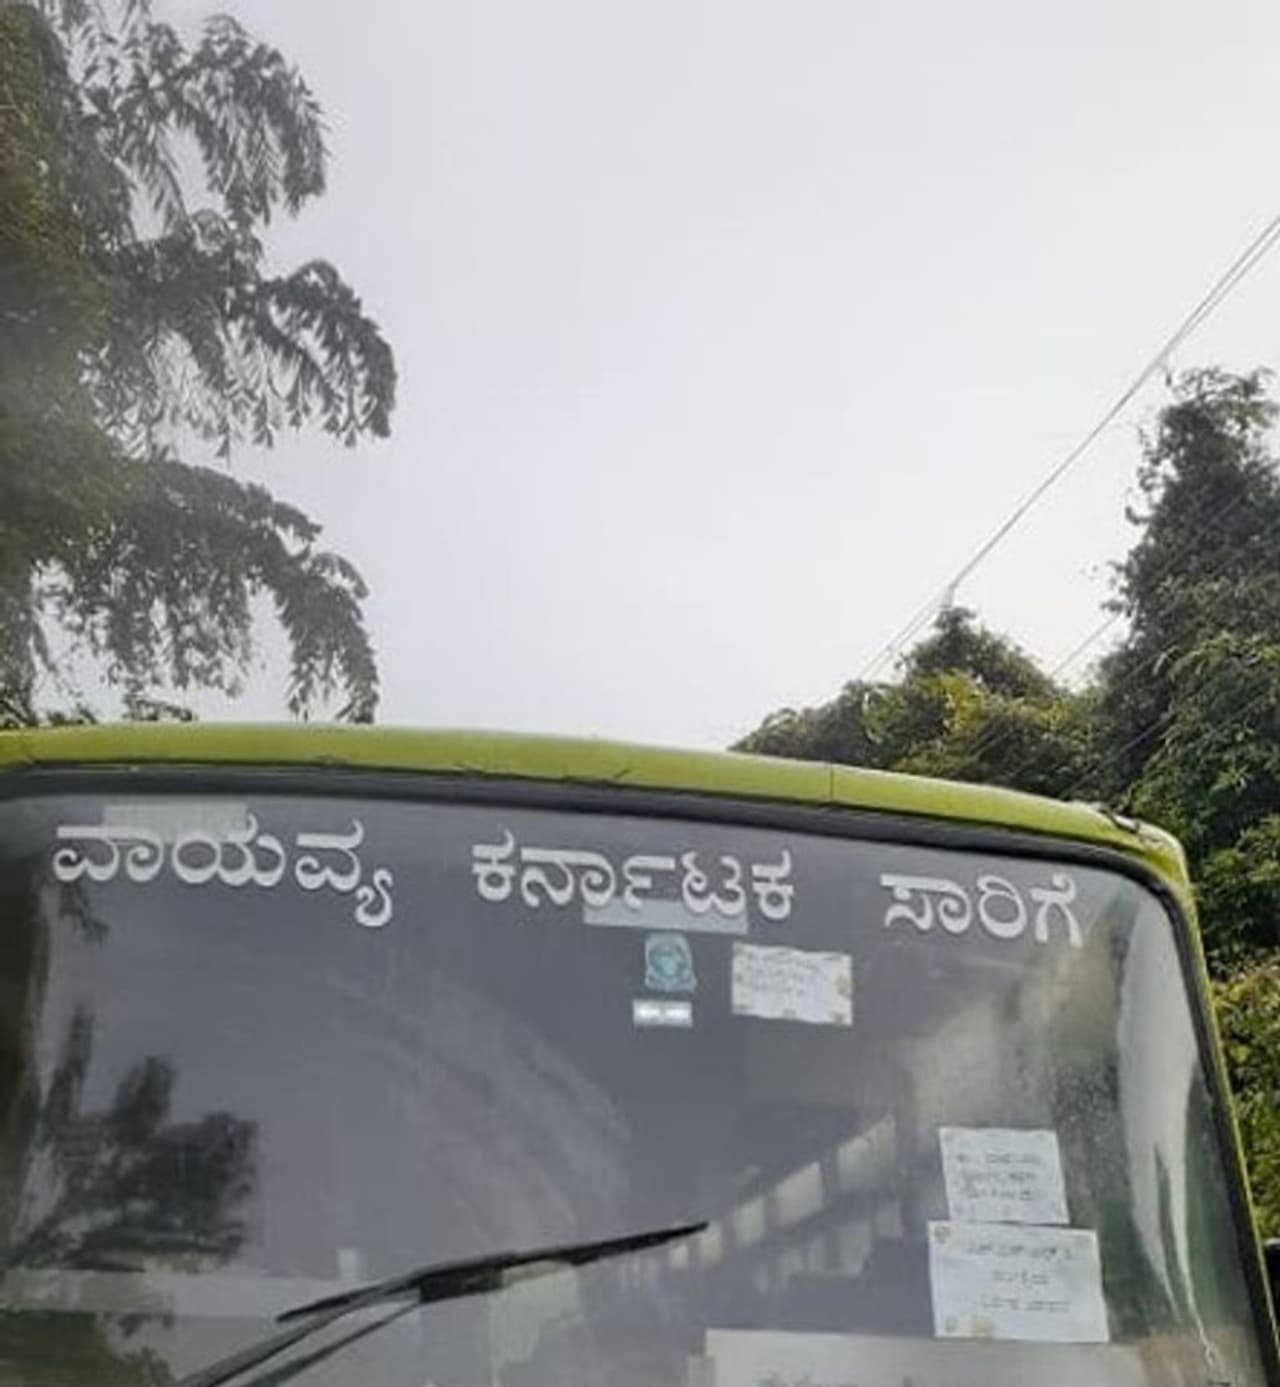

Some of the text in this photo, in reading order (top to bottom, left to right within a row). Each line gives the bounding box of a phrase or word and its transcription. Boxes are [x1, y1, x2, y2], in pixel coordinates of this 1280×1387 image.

[52, 813, 1083, 948] ವಾಯವ್ಯ ಕರ್ನಾಟಕ ಸಾರಿಗೆ
